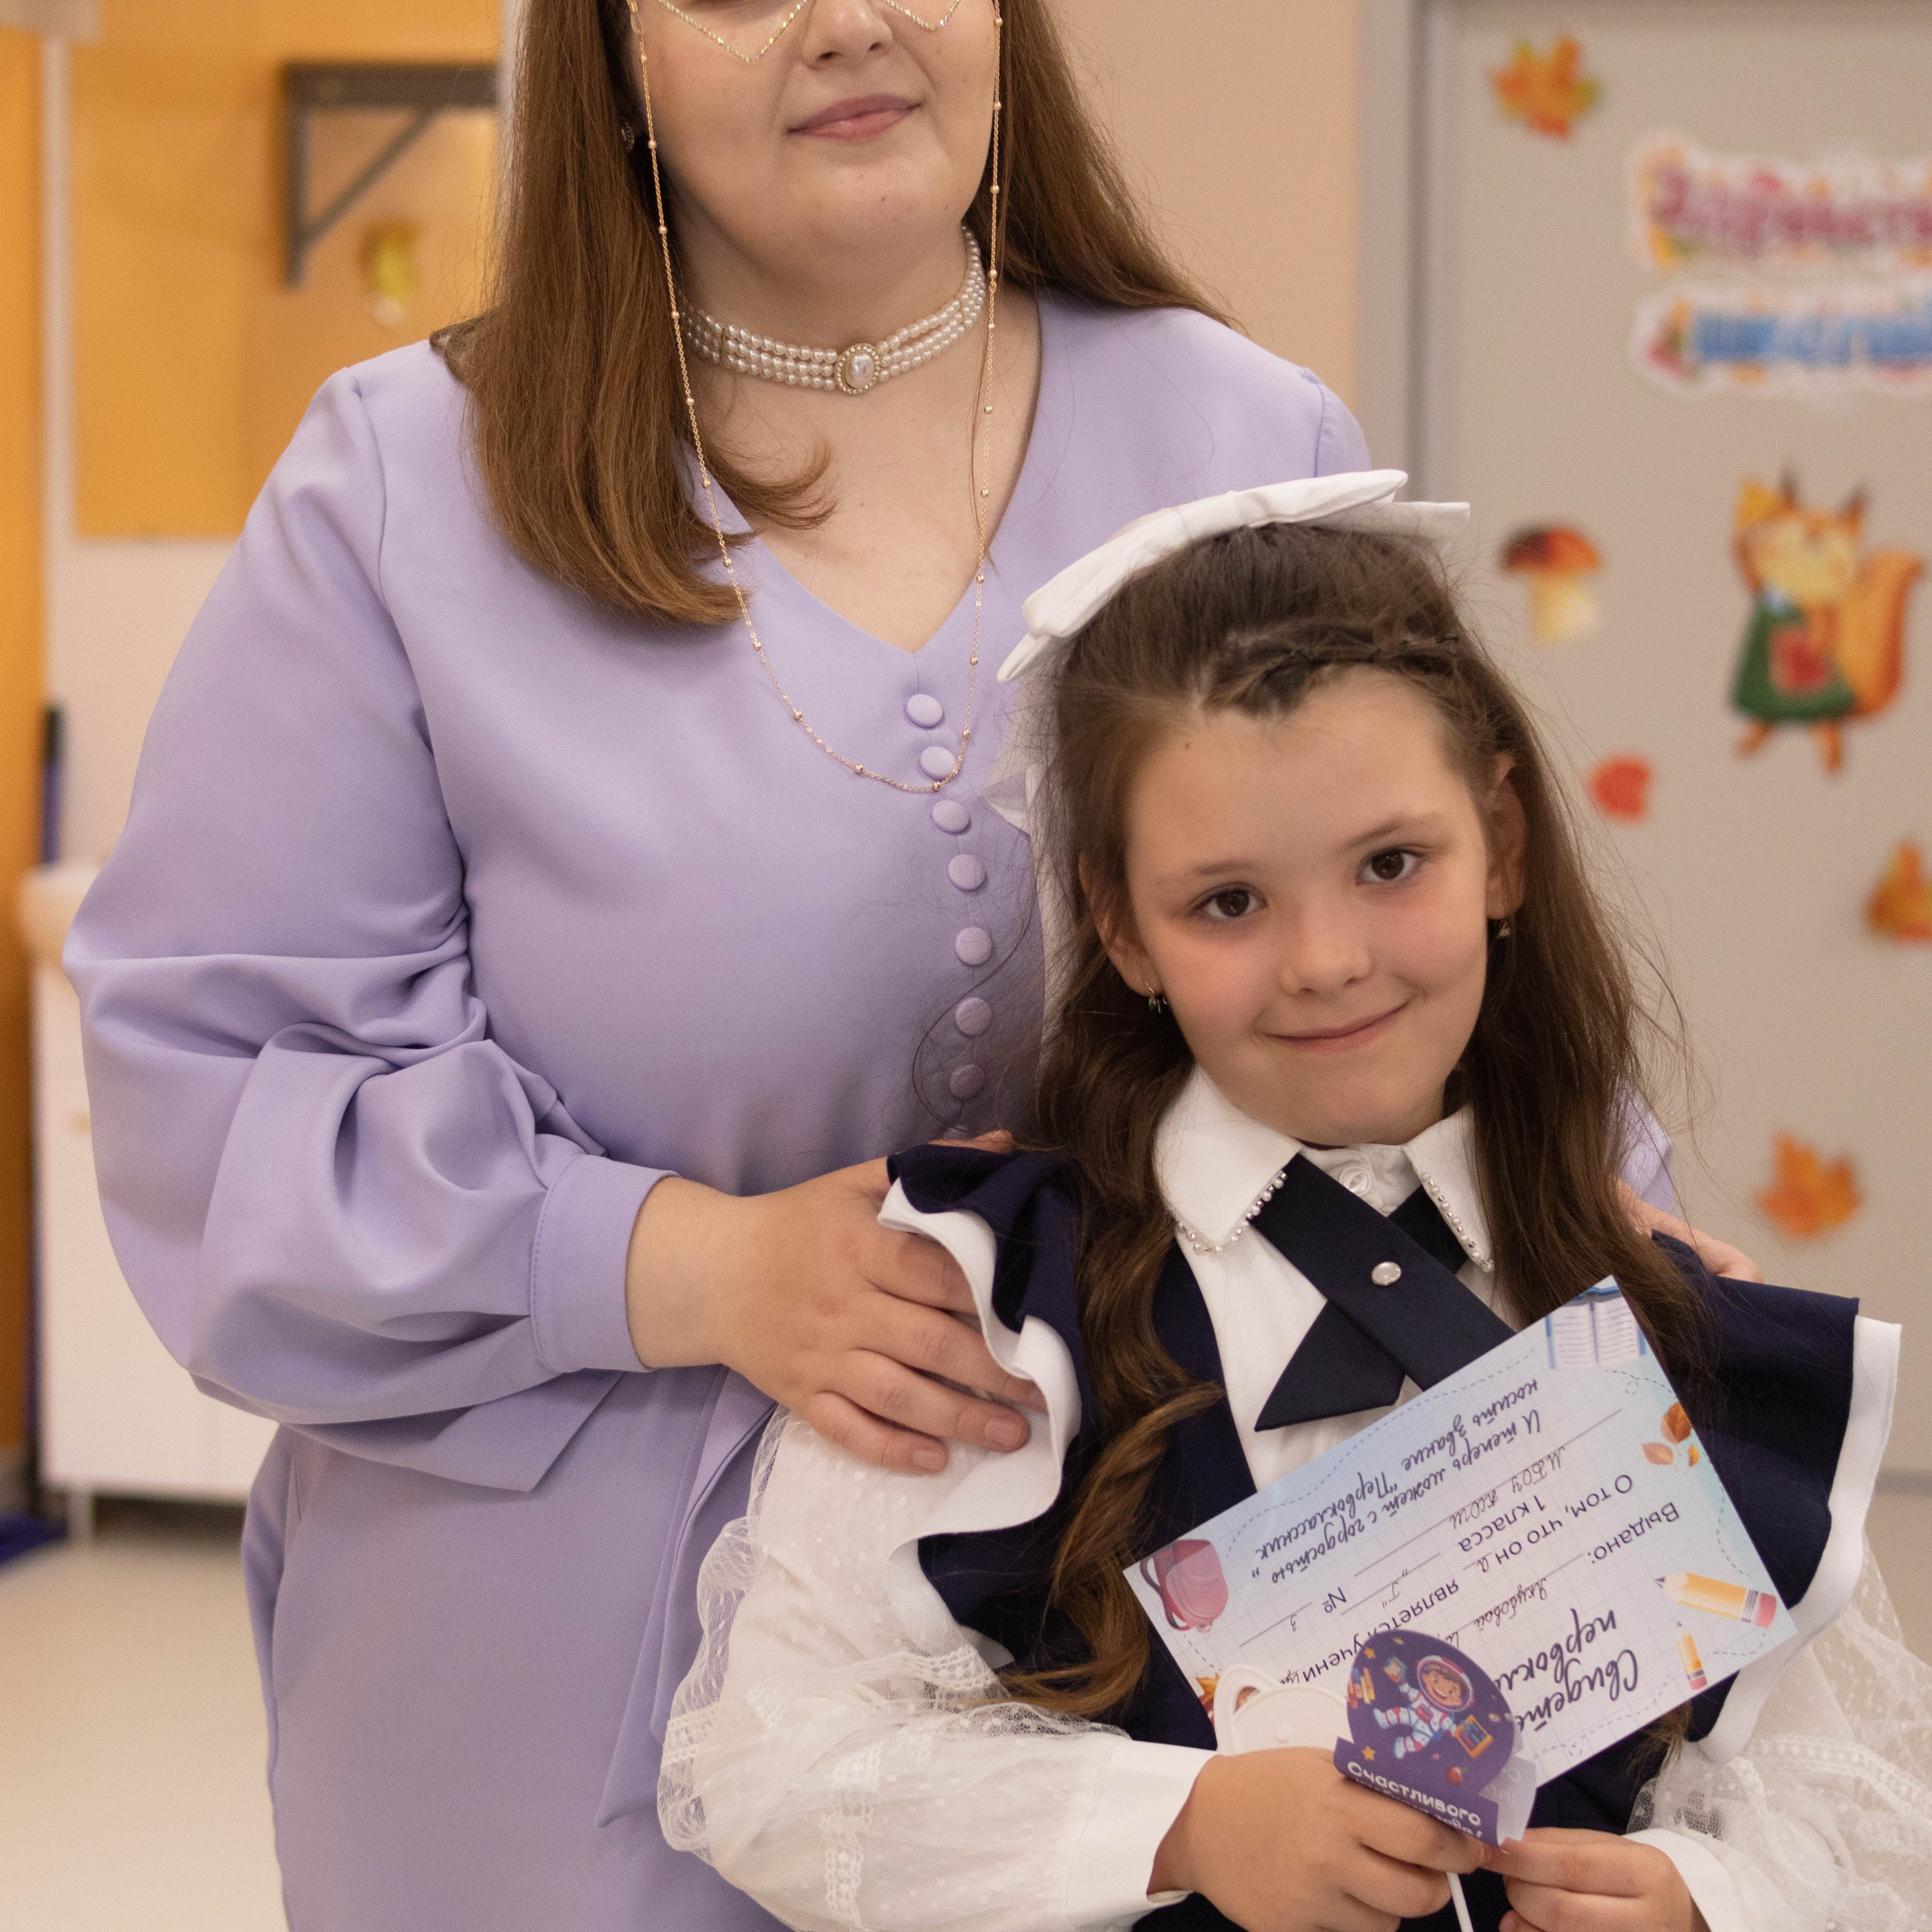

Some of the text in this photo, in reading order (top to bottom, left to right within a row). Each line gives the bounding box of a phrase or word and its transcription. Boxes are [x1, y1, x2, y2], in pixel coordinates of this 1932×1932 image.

[1472, 1379, 1538, 1426] носить
[1401, 1414, 1467, 1472] звание
[1271, 1409, 1540, 1584] И теперь может с гордостью
[1533, 1495, 1546, 1512] 1
[1564, 1487, 1611, 1518] том,
[1614, 1474, 1633, 1494] О
[1457, 1502, 1530, 1552] класса
[1527, 1520, 1563, 1544] что
[1587, 1502, 1680, 1564] Выдано:
[1322, 1586, 1347, 1614] №
[1347, 1761, 1481, 1826] Счастливого
